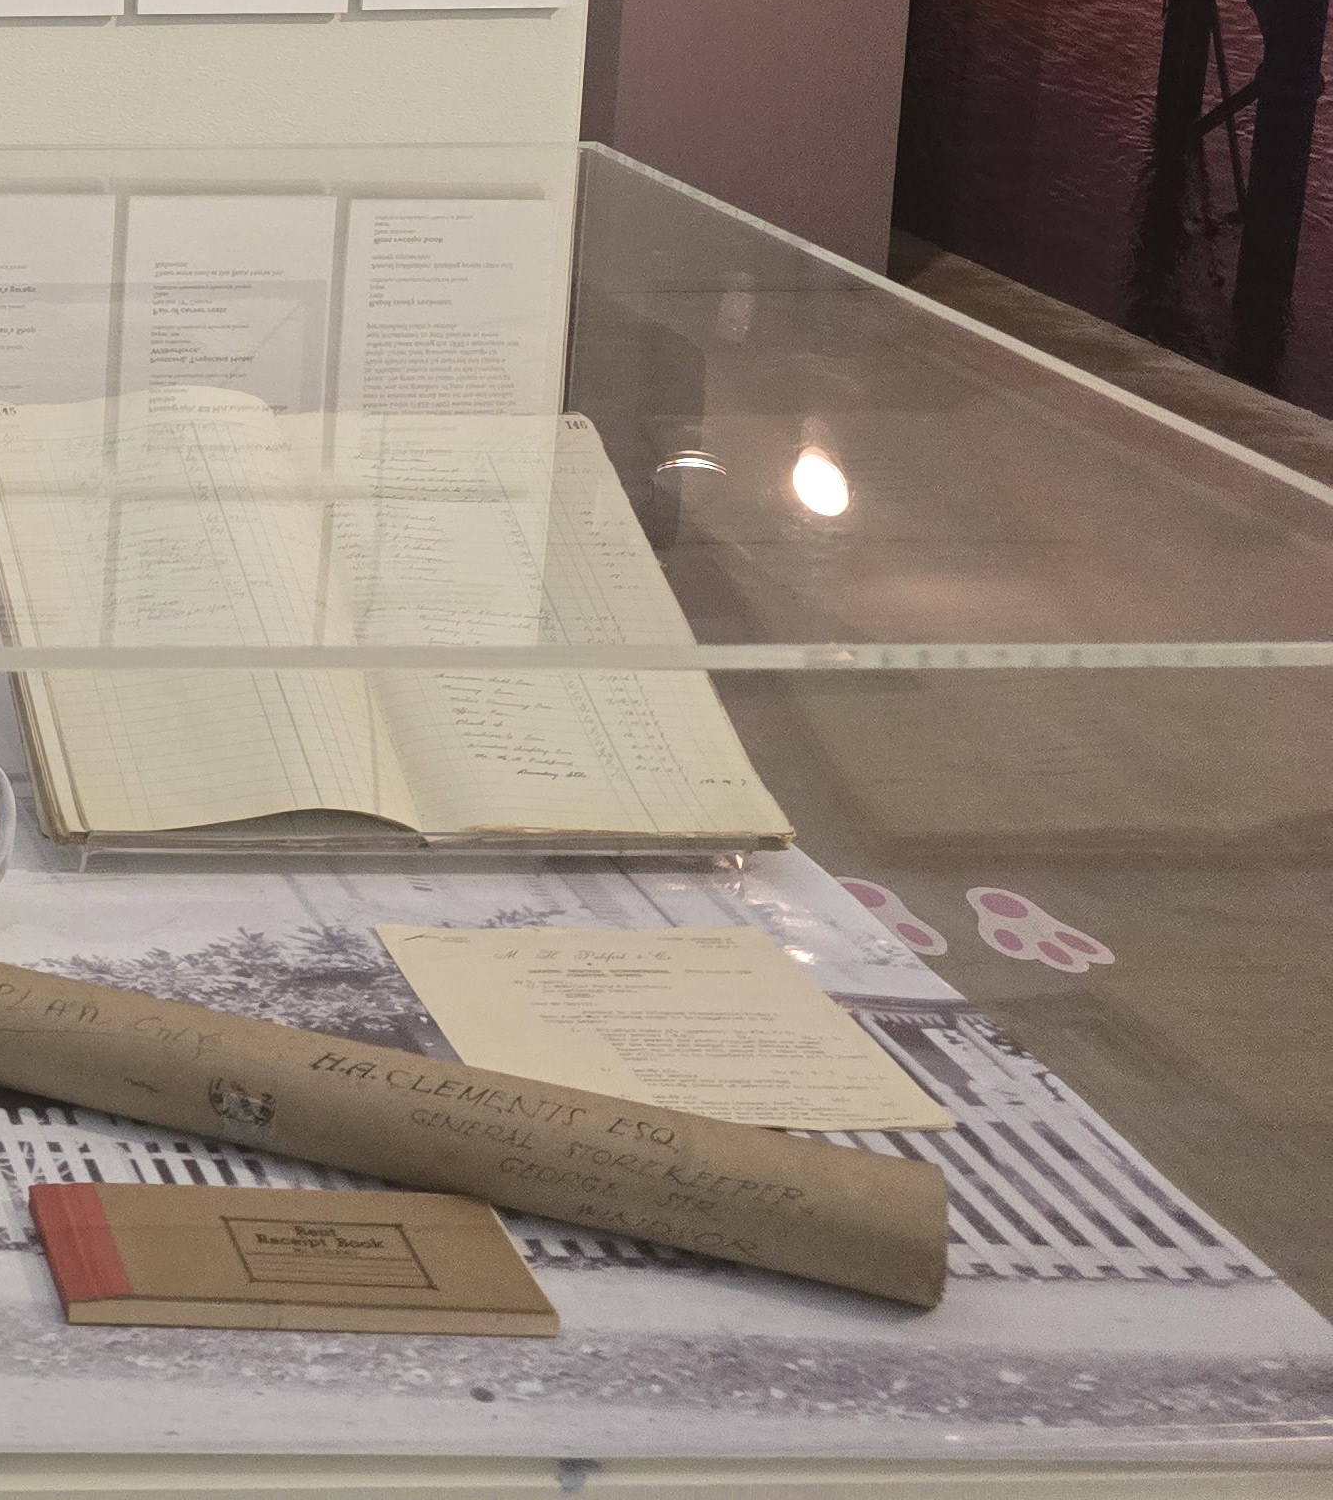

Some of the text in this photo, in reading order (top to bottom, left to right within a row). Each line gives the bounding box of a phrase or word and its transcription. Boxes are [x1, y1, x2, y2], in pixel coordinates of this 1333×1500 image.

[410, 1108, 533, 1151] GENERAL
[294, 1225, 337, 1237] Rent
[336, 1237, 385, 1248] Book
